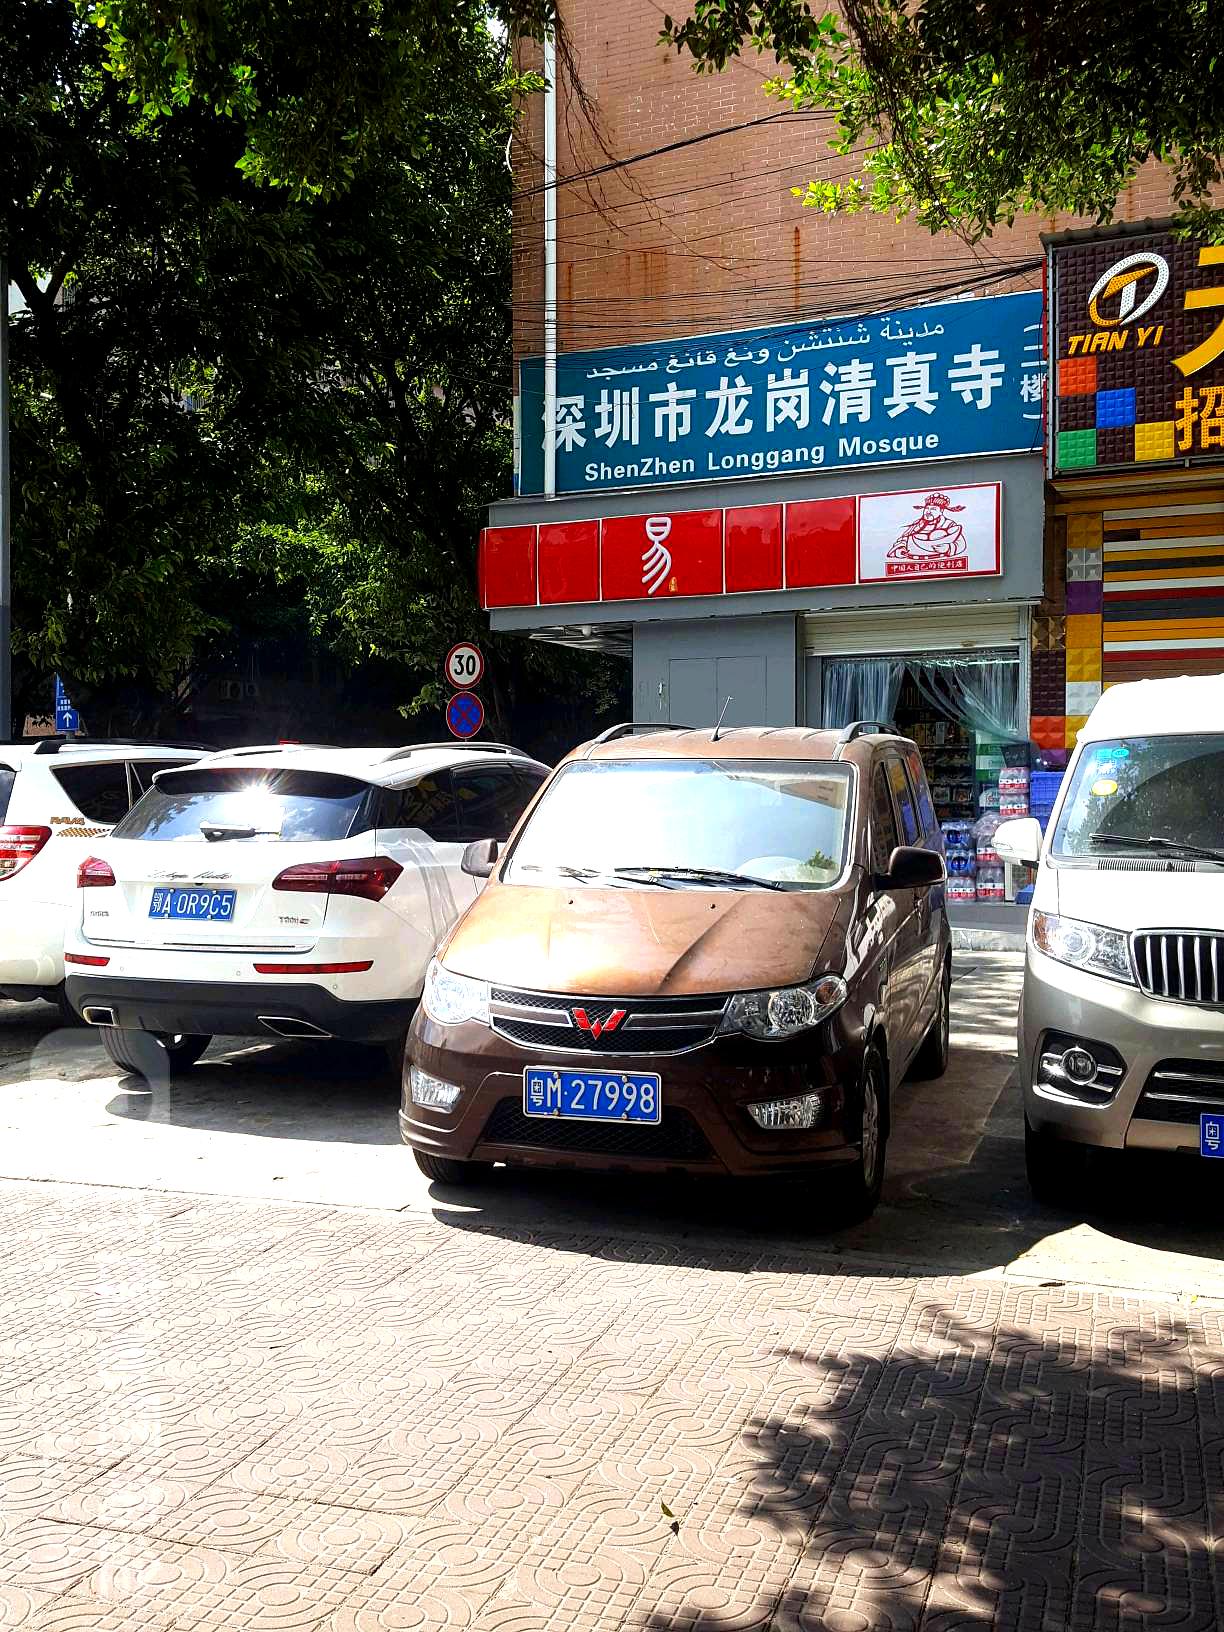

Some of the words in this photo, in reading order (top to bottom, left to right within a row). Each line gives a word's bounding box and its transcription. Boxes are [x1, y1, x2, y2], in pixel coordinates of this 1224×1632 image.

[1068, 330, 1129, 355] TIAN
[1137, 325, 1164, 347] YI
[586, 361, 658, 380] مسجد
[541, 344, 1004, 452] 深圳市龙岗清真寺
[584, 457, 695, 482] ShenZhen
[708, 444, 825, 471] Longgang
[838, 433, 939, 458] Mosque
[454, 655, 476, 676] 30
